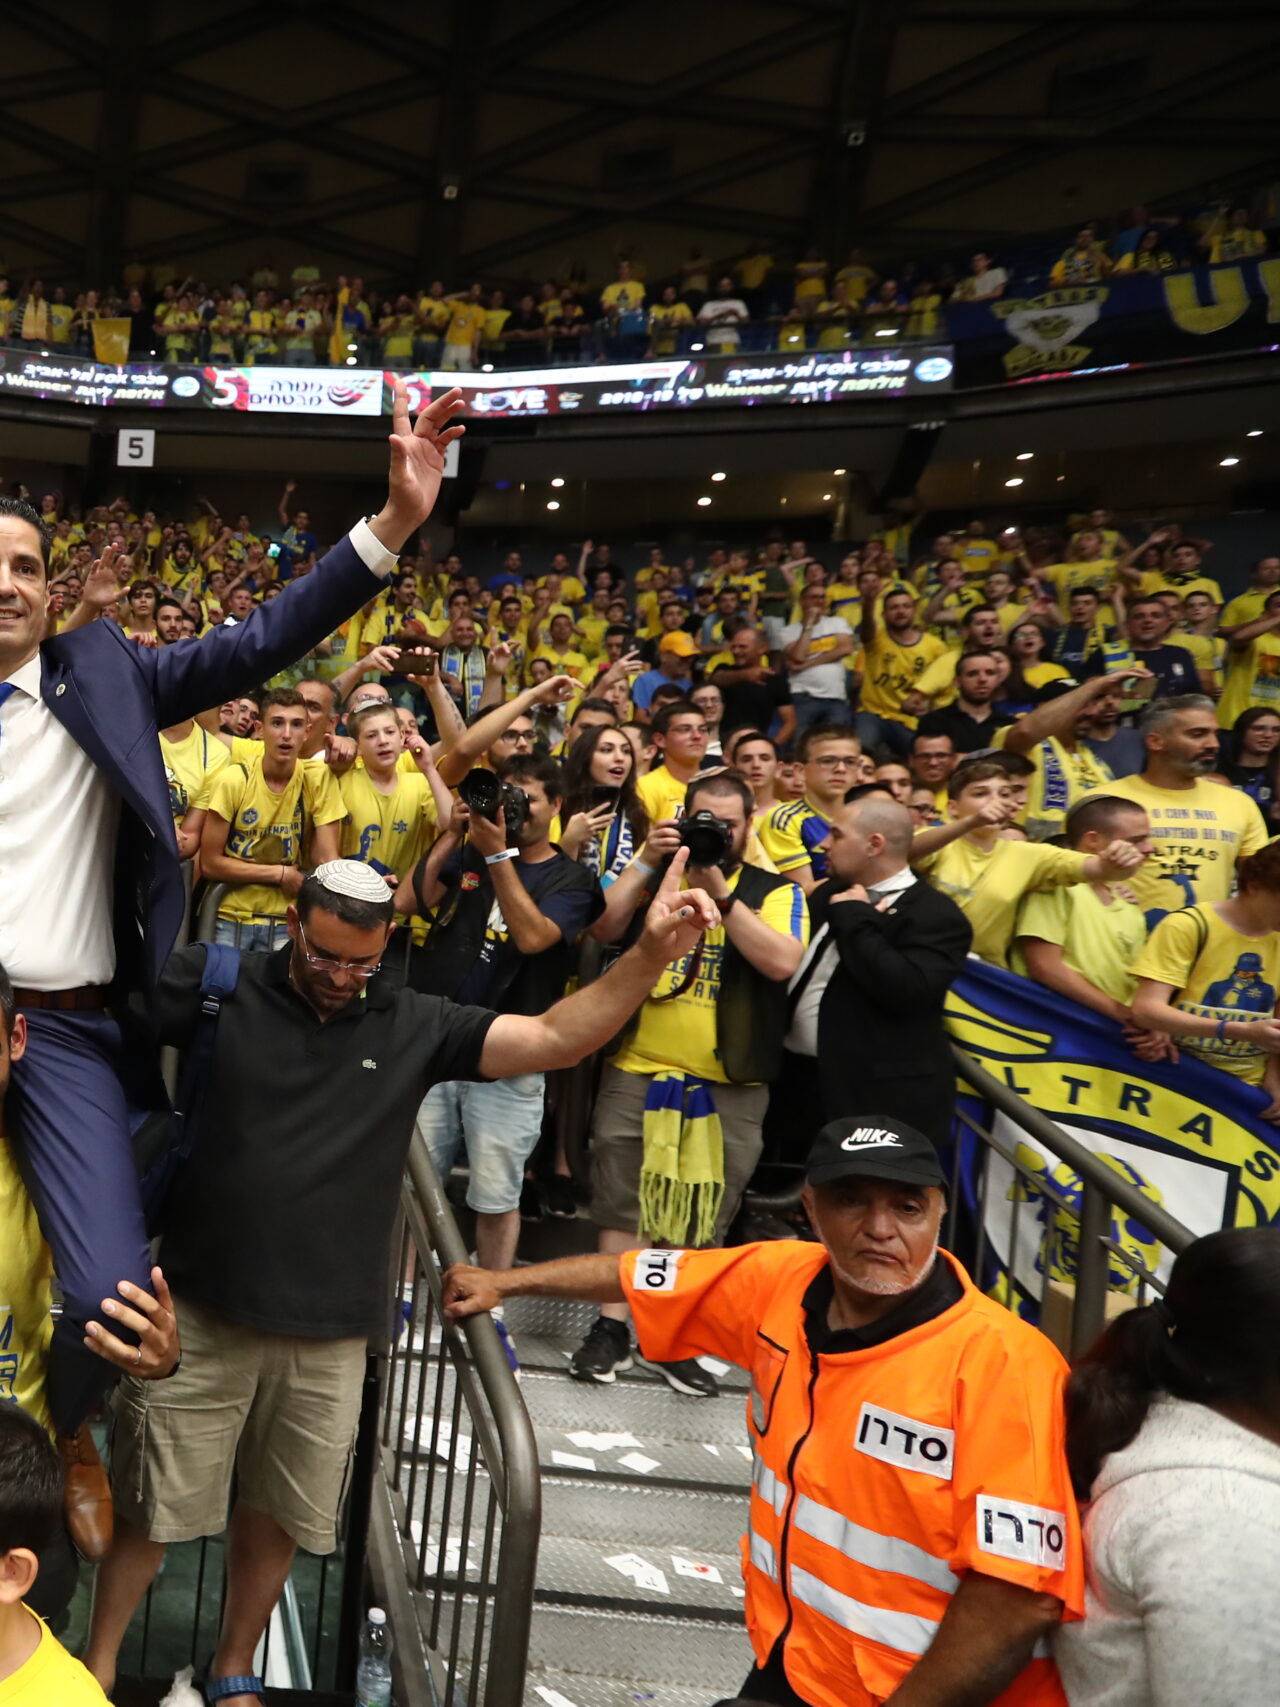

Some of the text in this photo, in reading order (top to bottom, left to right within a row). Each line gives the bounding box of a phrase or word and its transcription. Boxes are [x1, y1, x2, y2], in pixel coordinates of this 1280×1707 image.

[211, 370, 238, 407] 5
[474, 389, 546, 411] LOVE
[128, 437, 144, 459] 5
[1154, 845, 1219, 861] LTRAS
[850, 1128, 899, 1144] NIKE
[1003, 1065, 1280, 1182] LTRAS
[858, 1413, 948, 1462] סדרן
[983, 1508, 1063, 1553] סדרן
